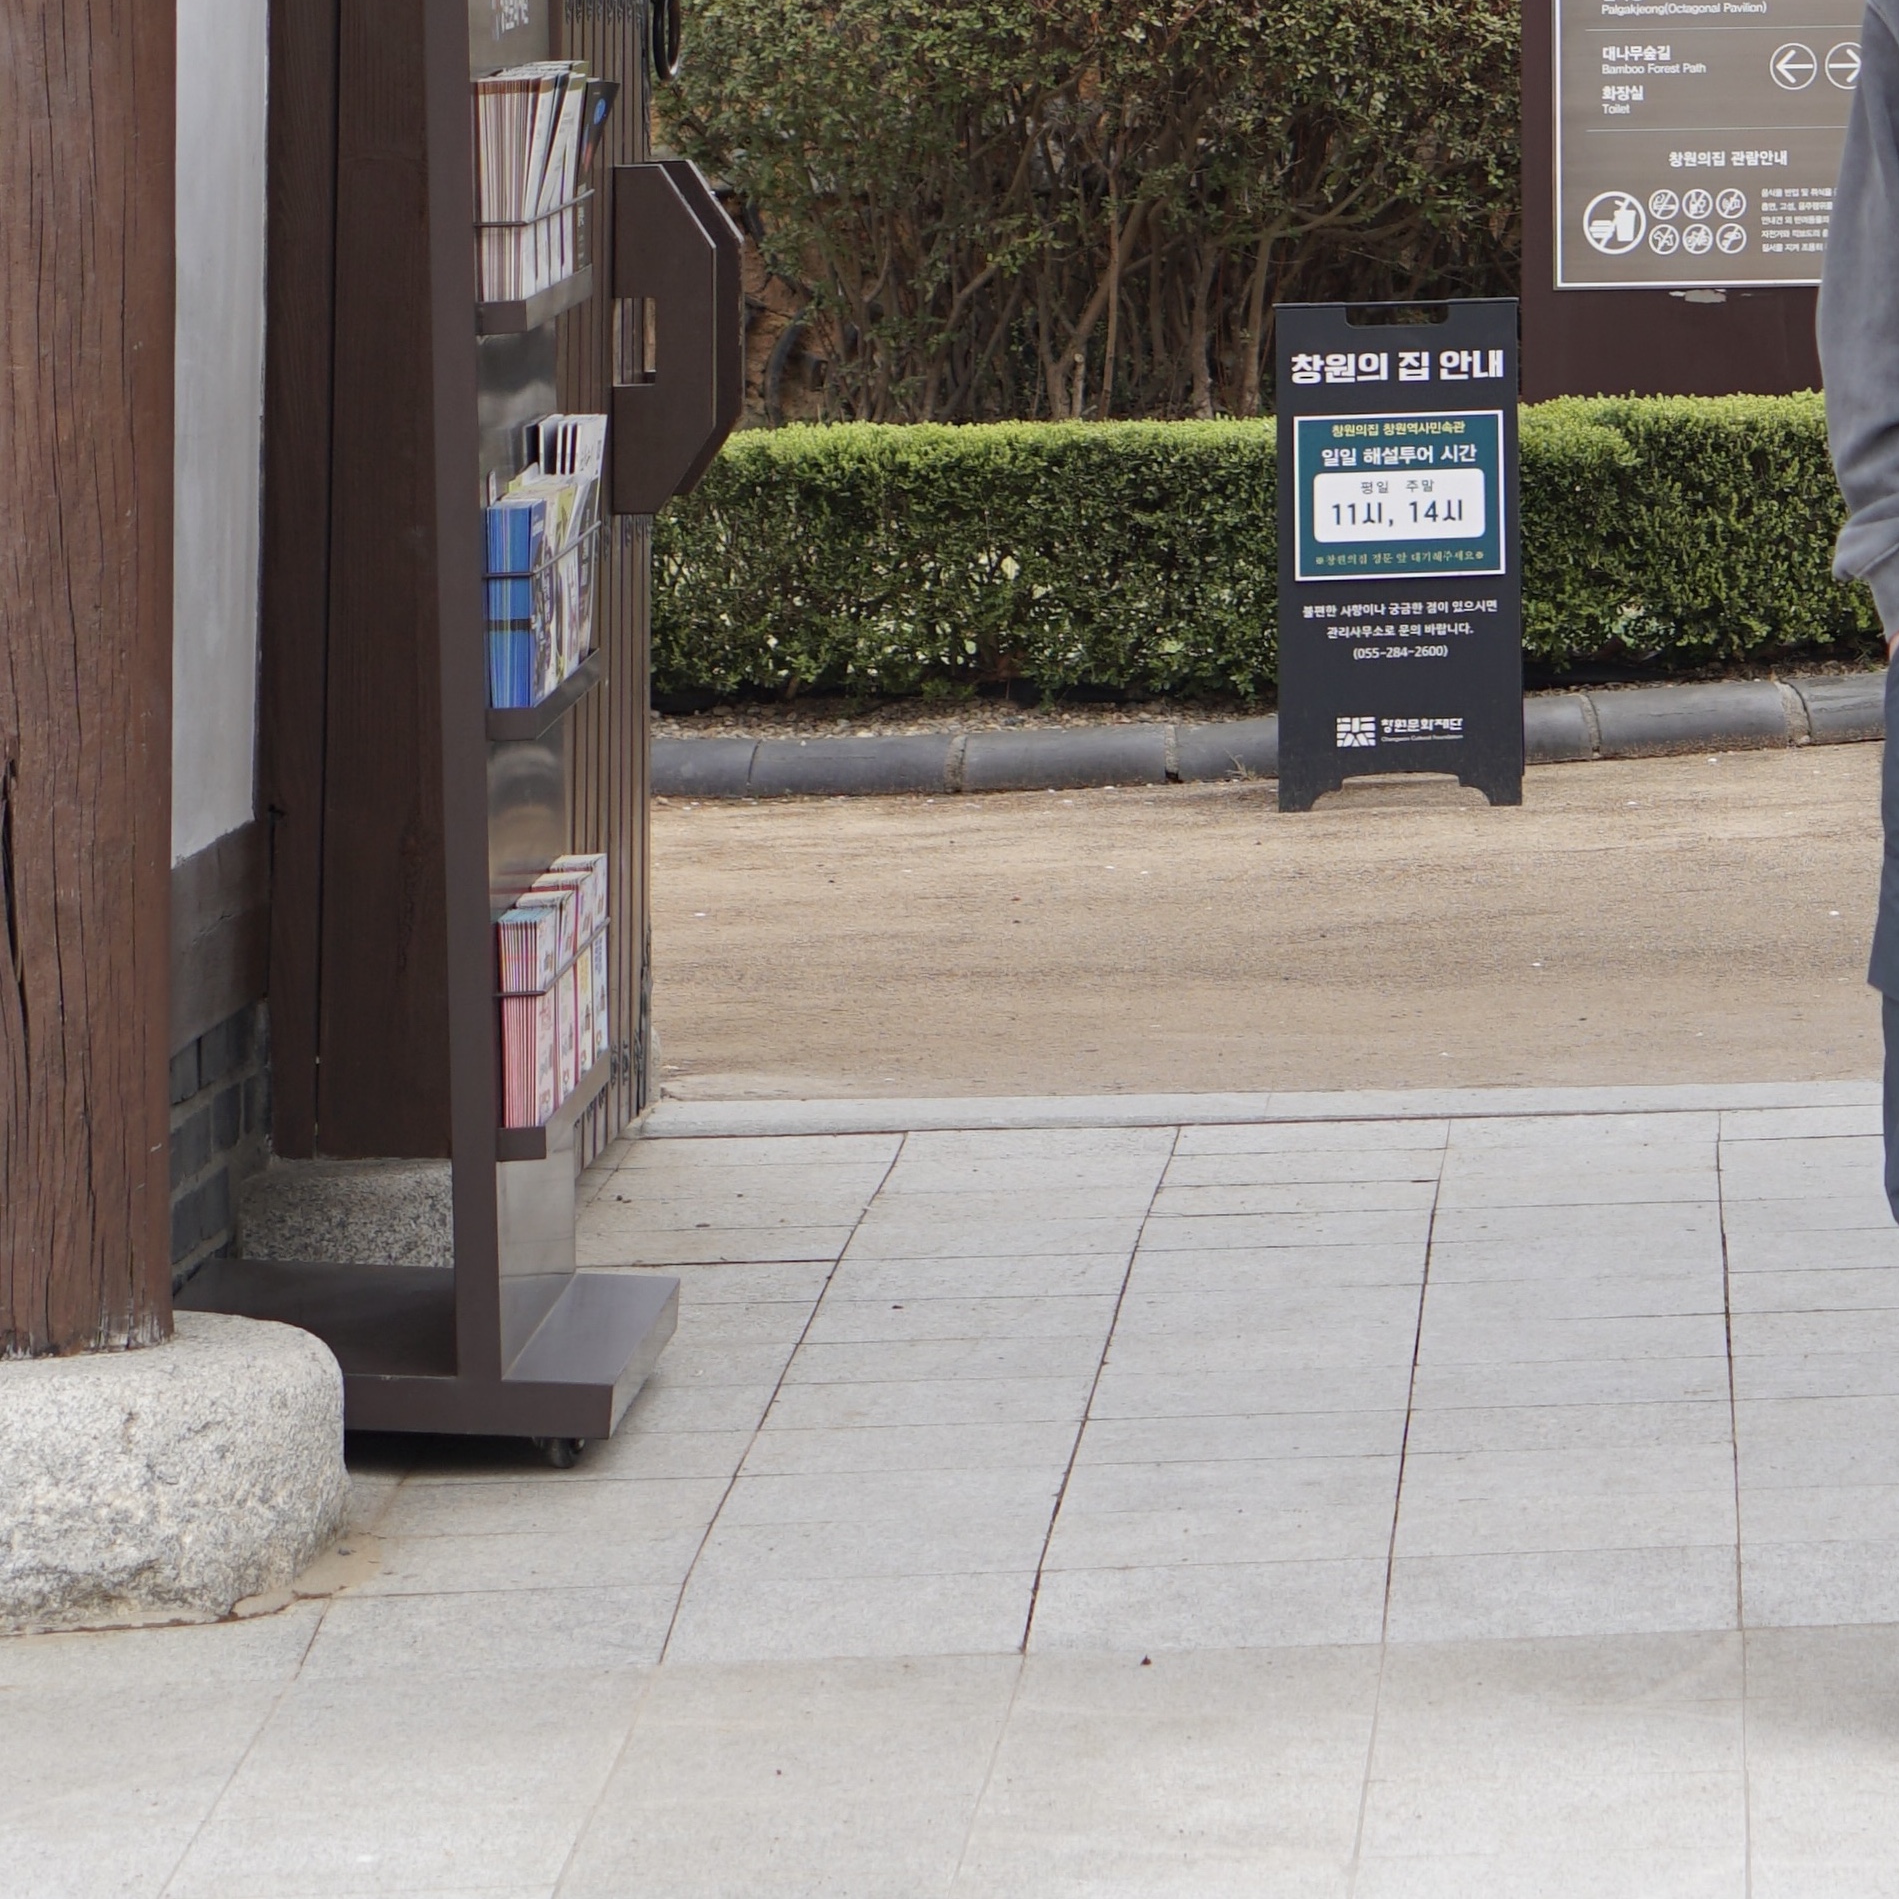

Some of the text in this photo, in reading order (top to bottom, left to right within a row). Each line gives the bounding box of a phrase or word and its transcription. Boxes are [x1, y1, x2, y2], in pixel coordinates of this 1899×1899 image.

[1602, 1, 1767, 16] Palgakjeong(Octagonal Pavilion)
[1603, 45, 1670, 61] 대나무숲길
[1602, 63, 1706, 74] Bamboo Forest Path
[1602, 85, 1644, 101] 화장실
[1602, 104, 1630, 114] Toilet
[1669, 150, 1787, 167] 창원의집 관람안내
[1292, 350, 1503, 384] 창원의 집 안내
[1332, 424, 1379, 437] 창원의집
[1322, 445, 1477, 466] 일일 해설투어 시간
[1361, 480, 1434, 494] 평일 주말
[1333, 500, 1462, 526] 11시, 14시
[1340, 604, 1386, 617] 사항이나
[1389, 602, 1423, 615] 궁금한
[1452, 600, 1497, 613] 있으시면
[1327, 622, 1474, 639] 관리사무소로 문의 바랍니다.
[1353, 645, 1448, 660] (055-284-2600)
[1381, 718, 1463, 733] 창원문화재단
